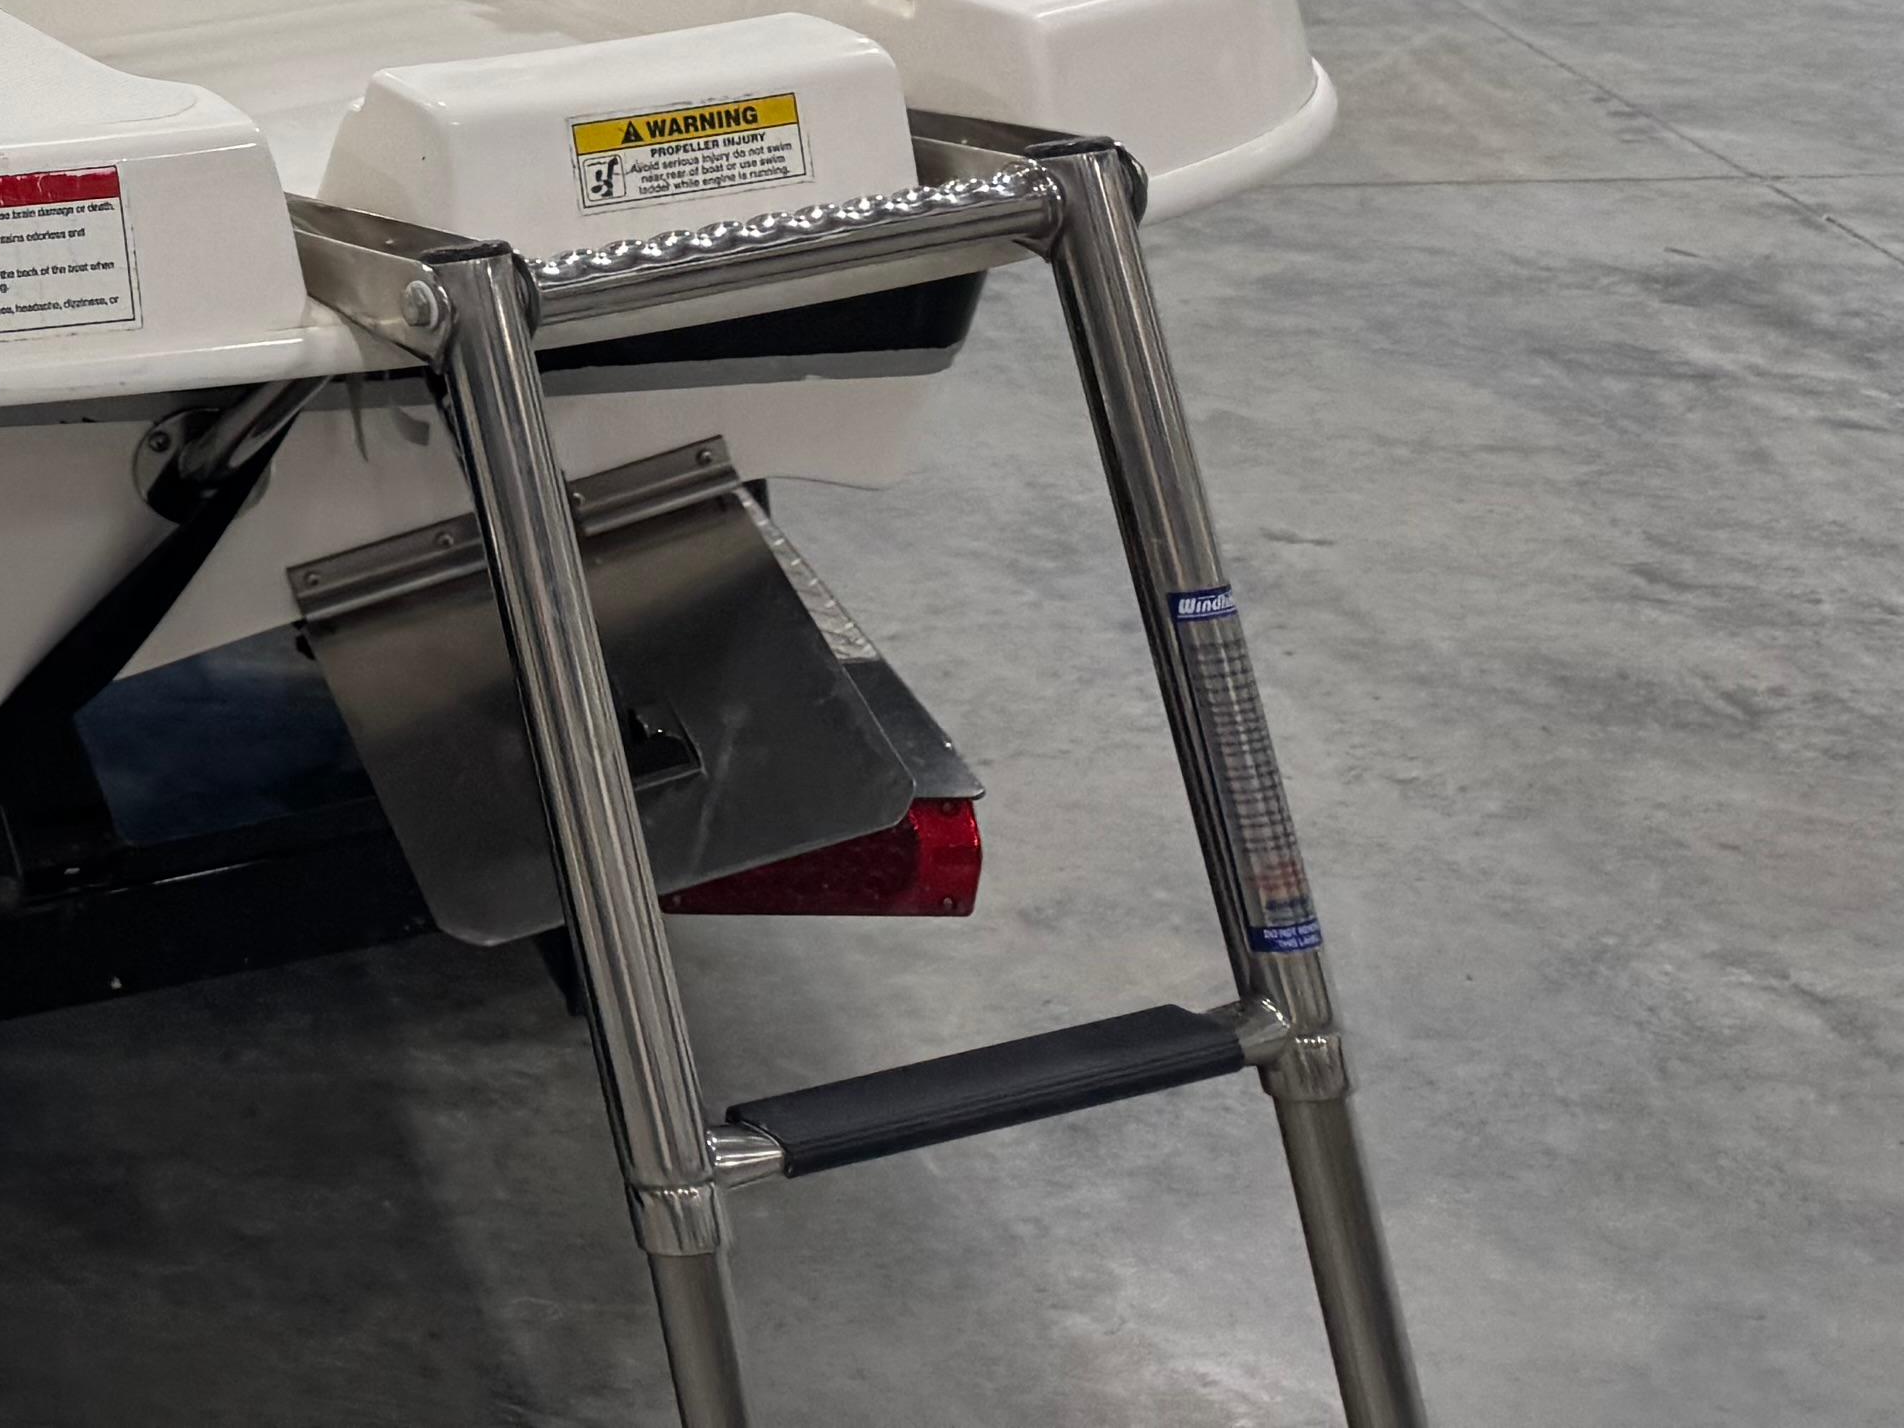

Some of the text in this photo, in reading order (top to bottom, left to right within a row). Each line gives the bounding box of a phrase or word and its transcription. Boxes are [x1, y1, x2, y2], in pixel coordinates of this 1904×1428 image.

[646, 106, 758, 139] WARNING
[631, 160, 659, 173] Avoid
[662, 155, 698, 169] serious
[733, 149, 745, 159] do
[749, 145, 764, 156] not
[767, 141, 792, 153] swim
[650, 132, 766, 157] PROPELLER INJURY
[667, 169, 685, 179] rear
[689, 167, 699, 177] of
[702, 163, 724, 175] boat
[727, 161, 736, 170] or
[740, 159, 757, 169] use
[760, 154, 785, 166] swim
[639, 182, 670, 194] ladder
[674, 177, 700, 190] while
[703, 173, 736, 186] engine
[739, 172, 747, 180] is
[76, 205, 85, 213] or
